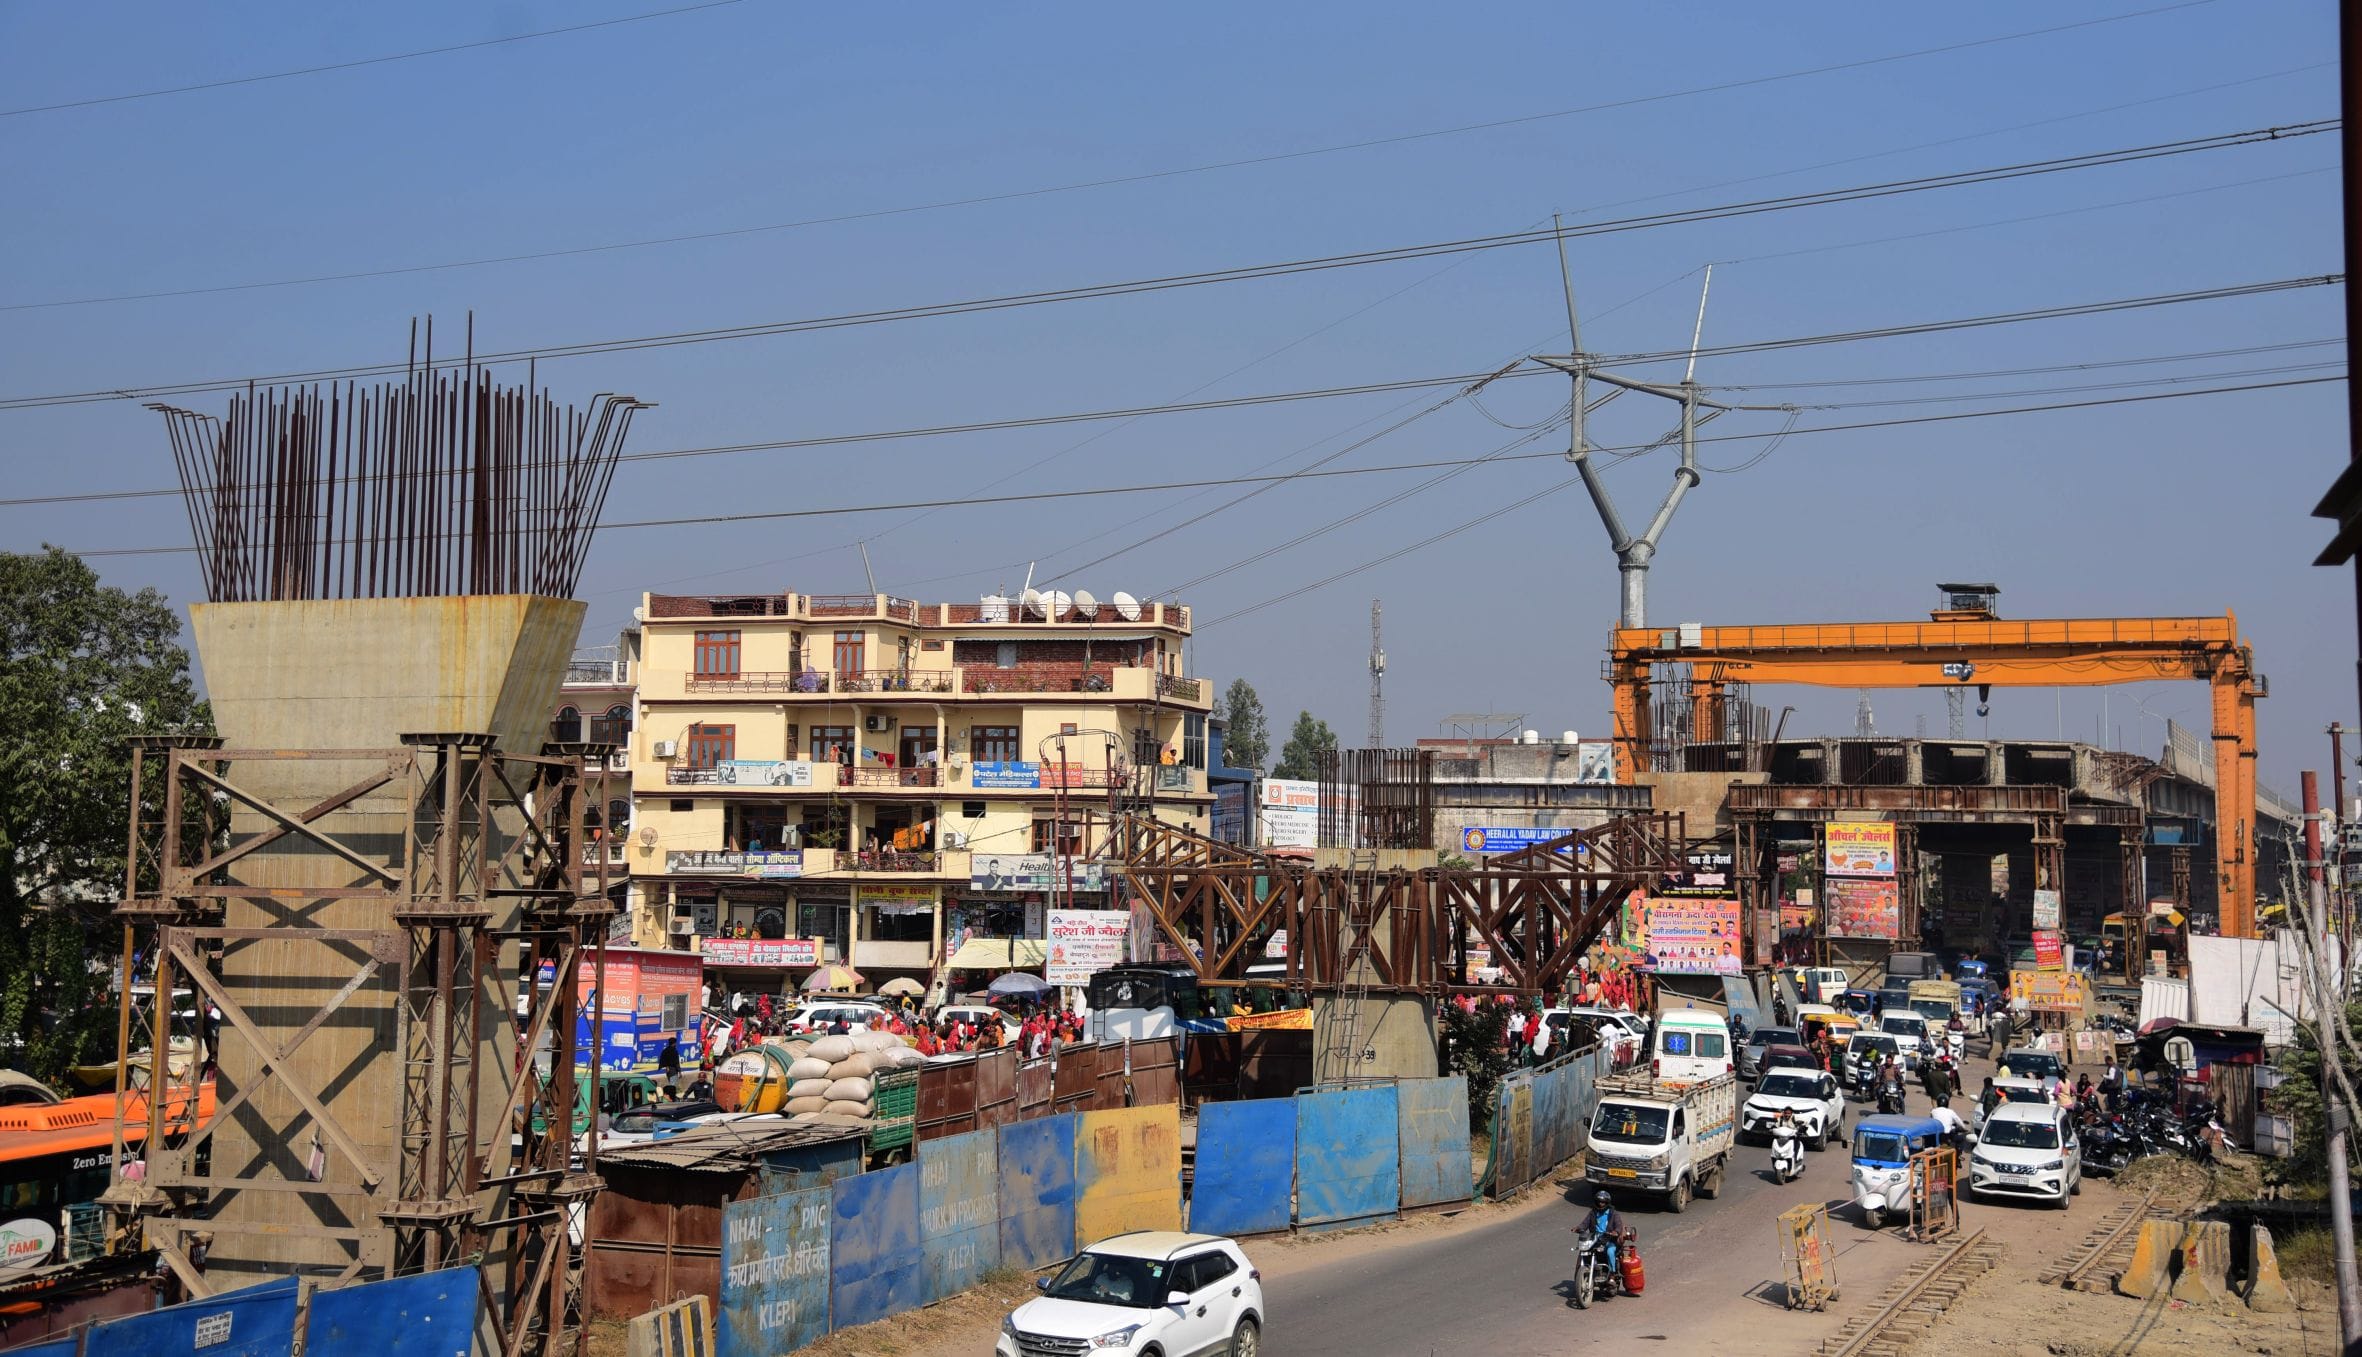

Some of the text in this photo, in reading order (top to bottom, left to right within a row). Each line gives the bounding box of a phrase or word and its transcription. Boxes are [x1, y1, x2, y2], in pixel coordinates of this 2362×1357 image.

[1486, 829, 1517, 839] HEERALAL
[1518, 829, 1537, 839] YADAV
[1538, 830, 1550, 839] LAW
[1052, 926, 1079, 938] सुरेश
[1081, 925, 1095, 937] जी
[73, 1157, 96, 1170] Zero
[923, 1159, 949, 1188] NHAI
[949, 1201, 957, 1227] IN
[729, 1215, 762, 1244] NHAI
[801, 1204, 827, 1231] PNC
